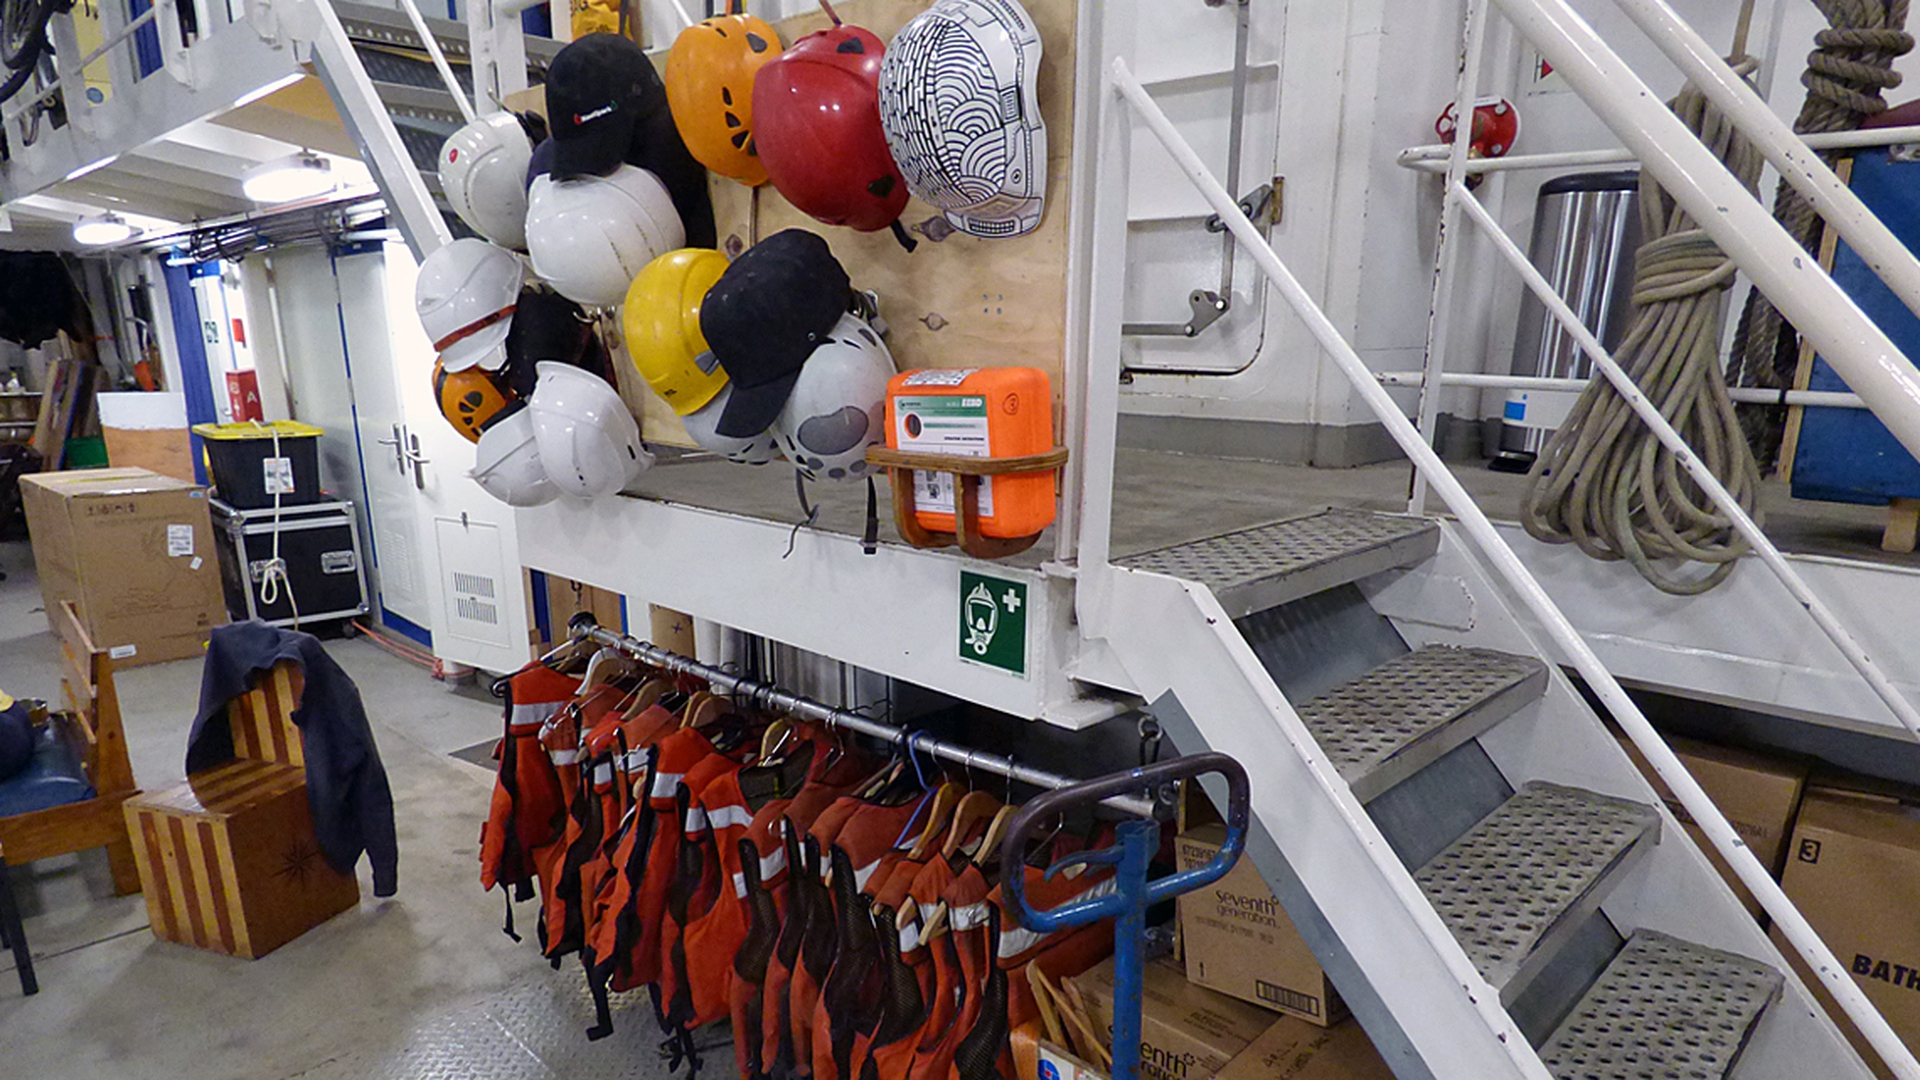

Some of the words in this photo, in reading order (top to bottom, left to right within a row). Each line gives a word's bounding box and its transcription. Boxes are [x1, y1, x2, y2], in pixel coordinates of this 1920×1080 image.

[1802, 840, 1818, 862] 3
[1215, 890, 1277, 916] seventh
[1852, 953, 1920, 992] BATH
